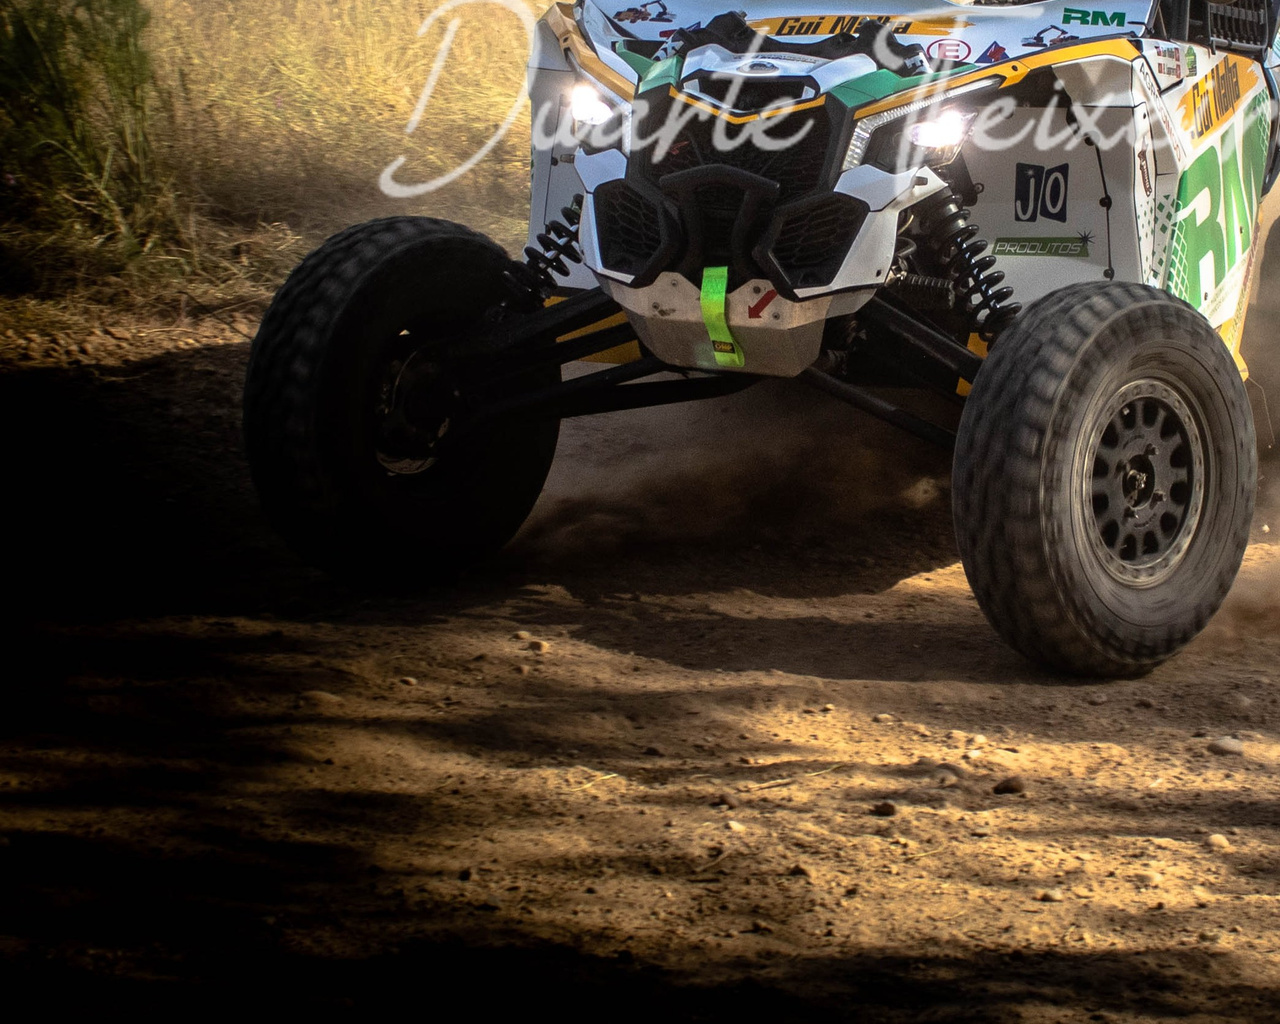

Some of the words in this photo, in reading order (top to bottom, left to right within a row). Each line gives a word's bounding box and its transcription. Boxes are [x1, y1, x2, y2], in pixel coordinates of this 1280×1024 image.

[775, 16, 824, 36] Gui
[1062, 7, 1126, 27] RM
[1192, 73, 1213, 139] Gui
[1211, 55, 1241, 122] Malha
[995, 241, 1083, 254] PRODUTOS
